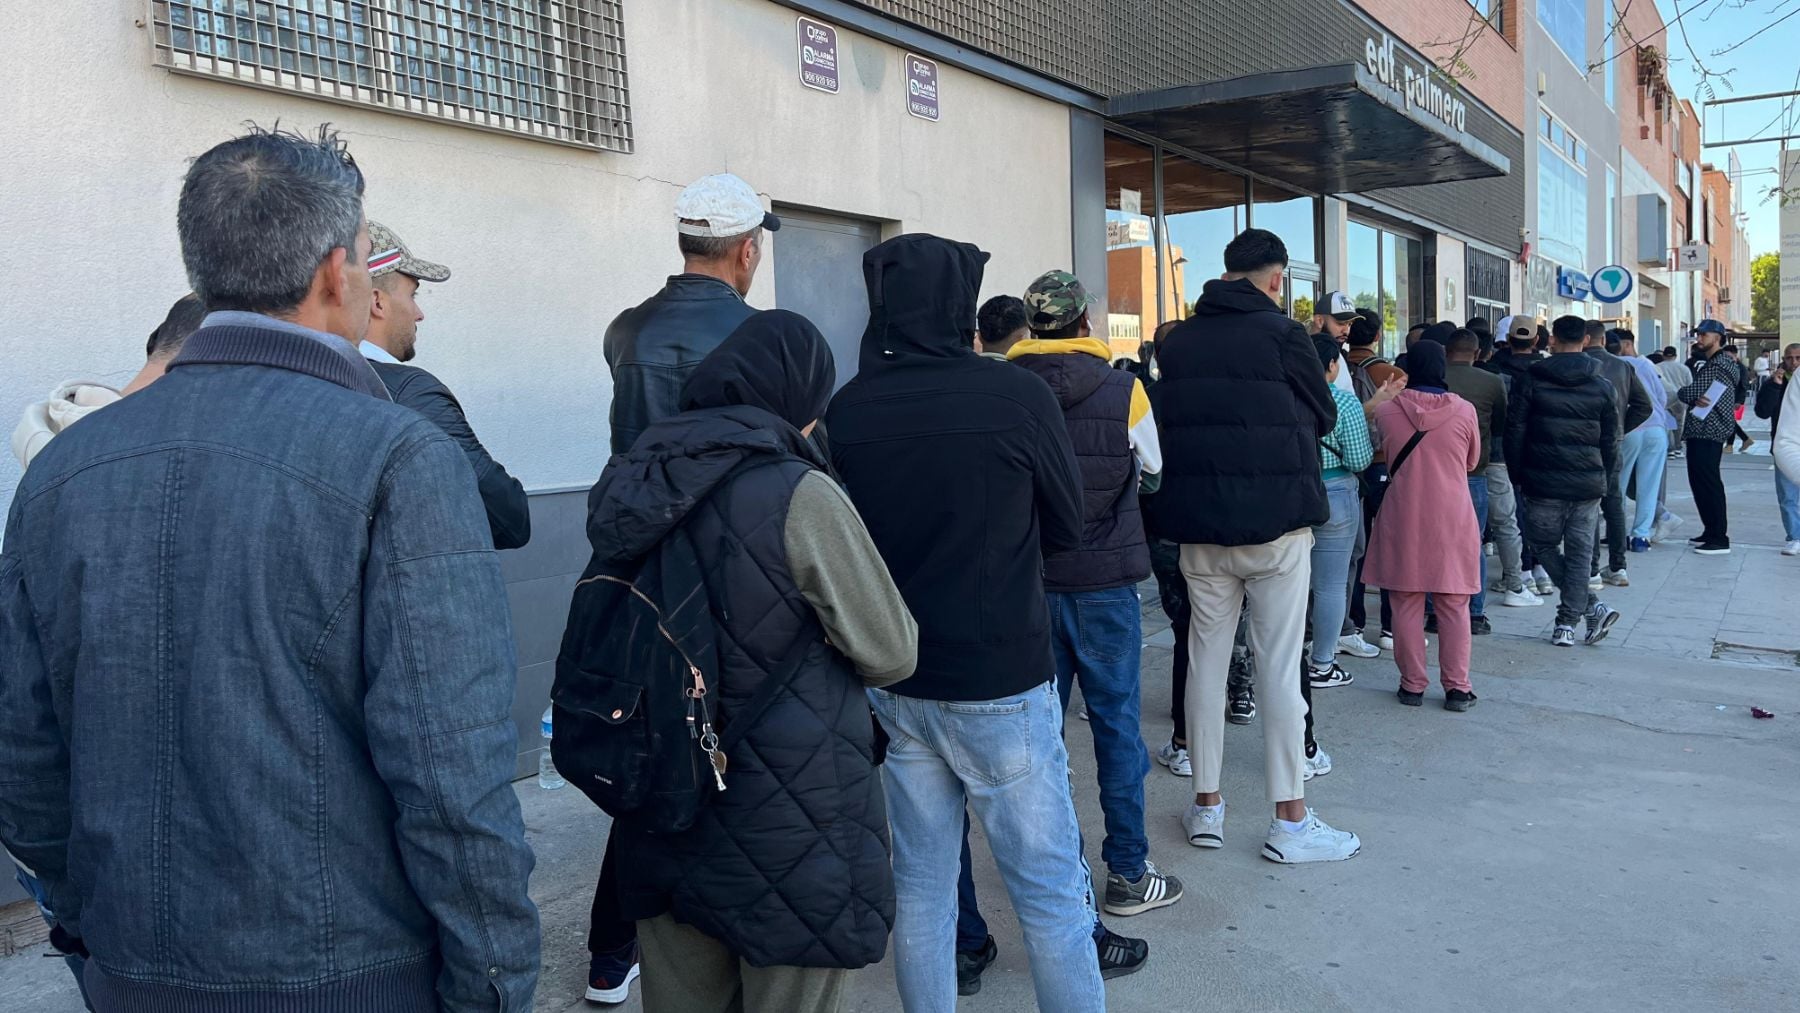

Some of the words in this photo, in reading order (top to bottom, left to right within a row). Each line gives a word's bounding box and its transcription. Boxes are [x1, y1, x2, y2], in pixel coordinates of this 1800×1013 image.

[814, 49, 834, 61] ALARMA
[919, 82, 936, 92] ALARMA
[1366, 33, 1400, 92] edf.
[1404, 64, 1466, 133] palmera
